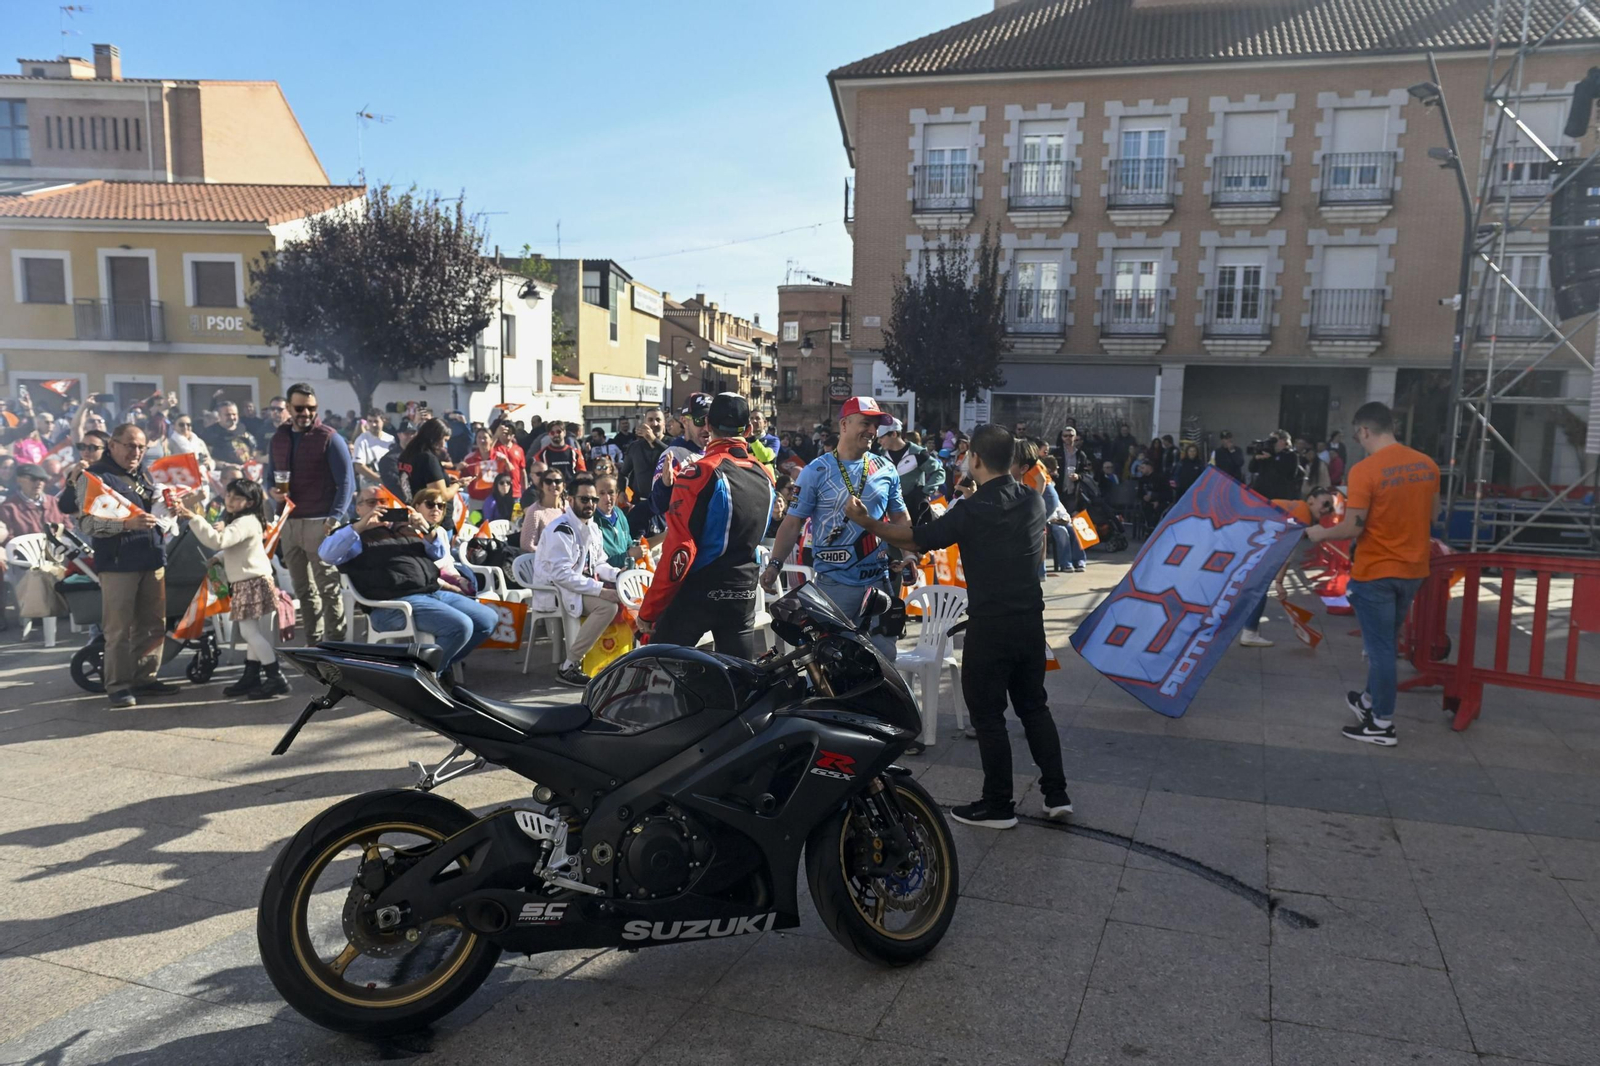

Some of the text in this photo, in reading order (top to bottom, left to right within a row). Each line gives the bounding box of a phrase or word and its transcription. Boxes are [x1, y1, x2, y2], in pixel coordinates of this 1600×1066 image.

[206, 316, 244, 331] PSOE
[1382, 462, 1430, 478] OFFICIAL
[1381, 471, 1437, 489] FAN CLUB
[820, 551, 847, 562] SHOEI
[810, 767, 856, 781] GSX
[519, 902, 568, 917] SC
[621, 912, 777, 941] SUZUKI
